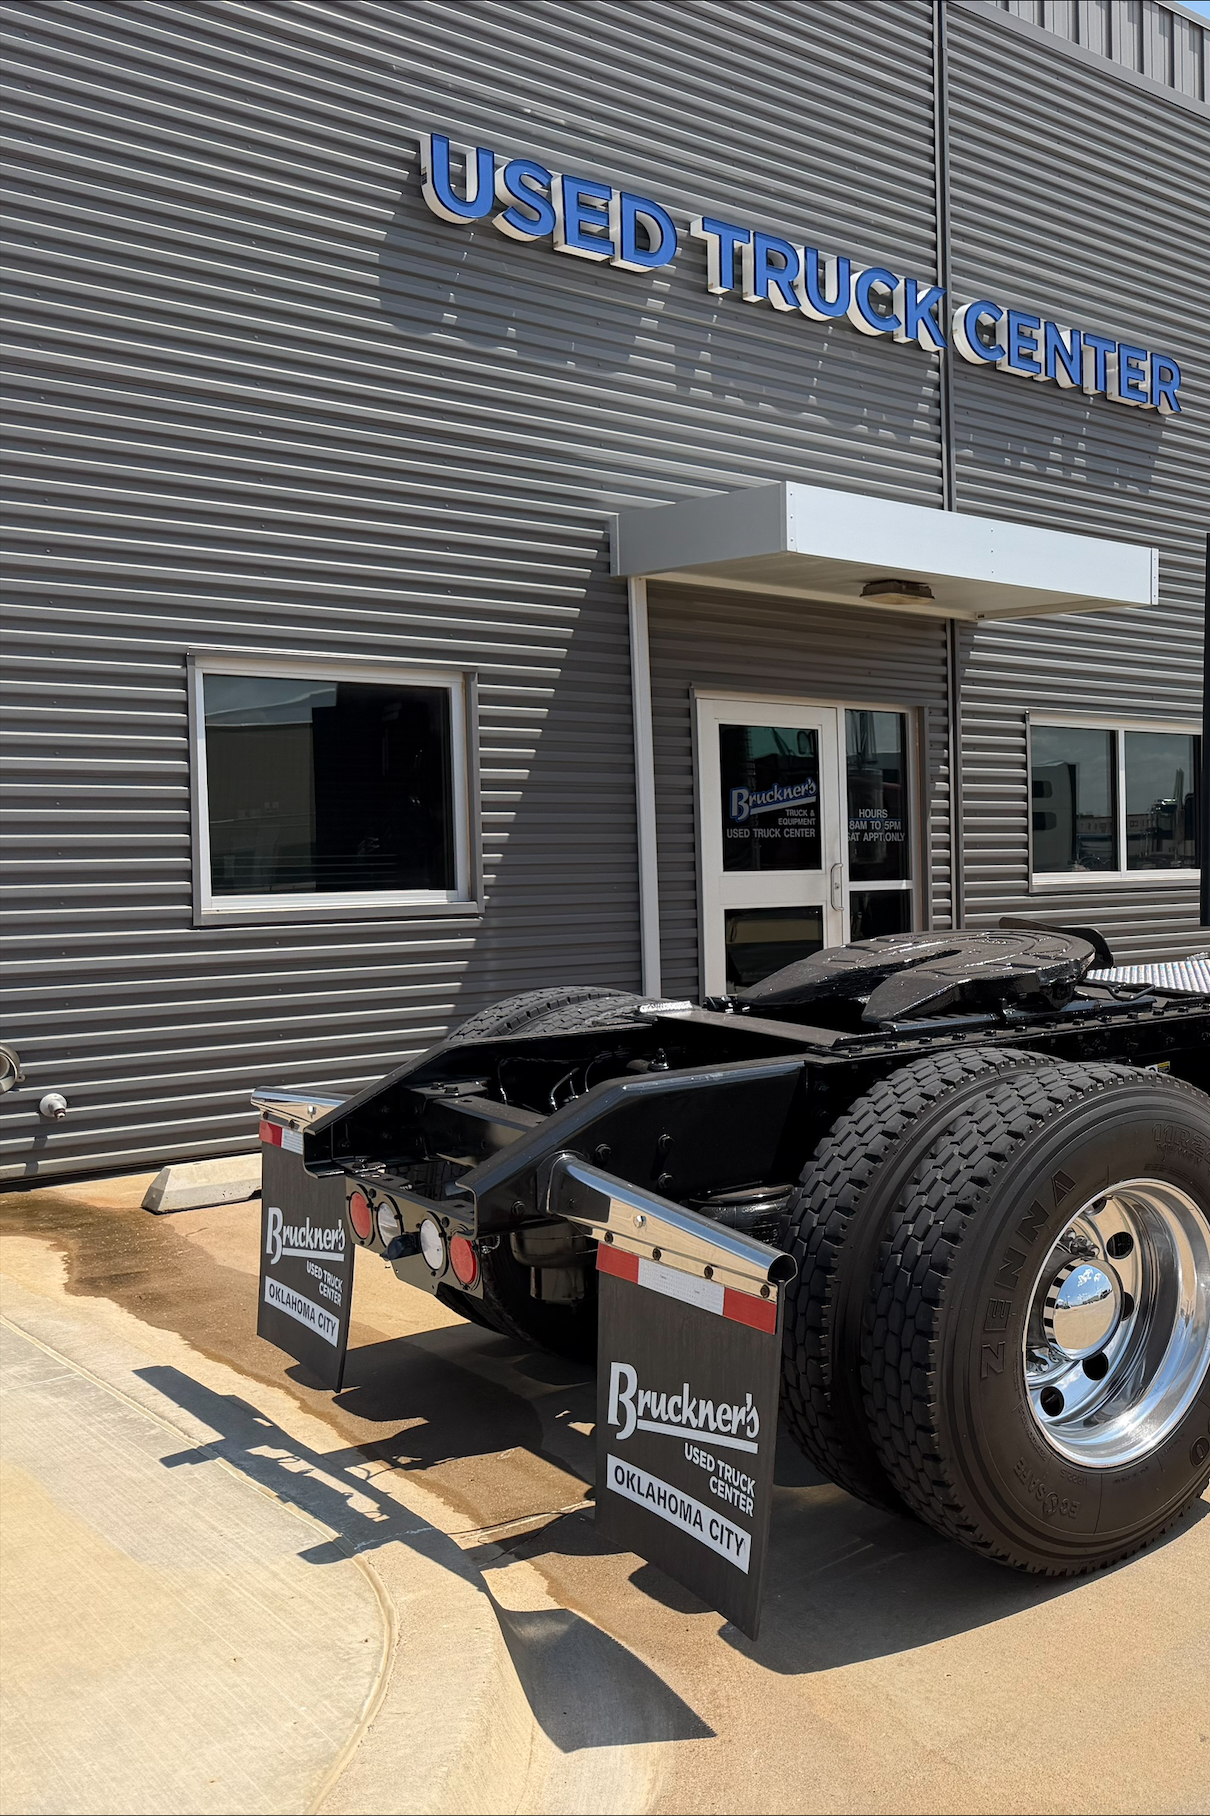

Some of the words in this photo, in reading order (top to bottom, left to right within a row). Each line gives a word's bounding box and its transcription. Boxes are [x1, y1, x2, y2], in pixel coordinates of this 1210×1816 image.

[421, 132, 679, 273] USED
[691, 216, 947, 352] TRUCK
[952, 299, 1182, 416] CENTER
[730, 778, 817, 822] Bruckner's
[785, 809, 808, 817] TRUCK
[858, 808, 888, 819] HOURS
[727, 829, 751, 839] USED
[753, 828, 781, 838] TRUCK
[784, 828, 816, 838] CENTER
[778, 818, 816, 826] EQUIPMENT
[848, 820, 868, 830] 8AM
[870, 820, 882, 830] TO
[884, 820, 902, 830] 5PM
[266, 1207, 346, 1265] Bruckner's
[306, 1261, 323, 1278] USED
[323, 1271, 343, 1292] TRUCK
[319, 1282, 342, 1306] CENTER
[981, 1169, 1077, 1380] ZENNA
[269, 1283, 316, 1325] OKLAHOMA
[317, 1313, 337, 1338] CITY
[608, 1361, 760, 1440] Bruckner's
[684, 1443, 715, 1472] USED
[717, 1459, 756, 1499] TRUCK
[613, 1464, 704, 1534] OKLAHOMA
[709, 1516, 746, 1558] CITY
[708, 1476, 755, 1518] CENTER
